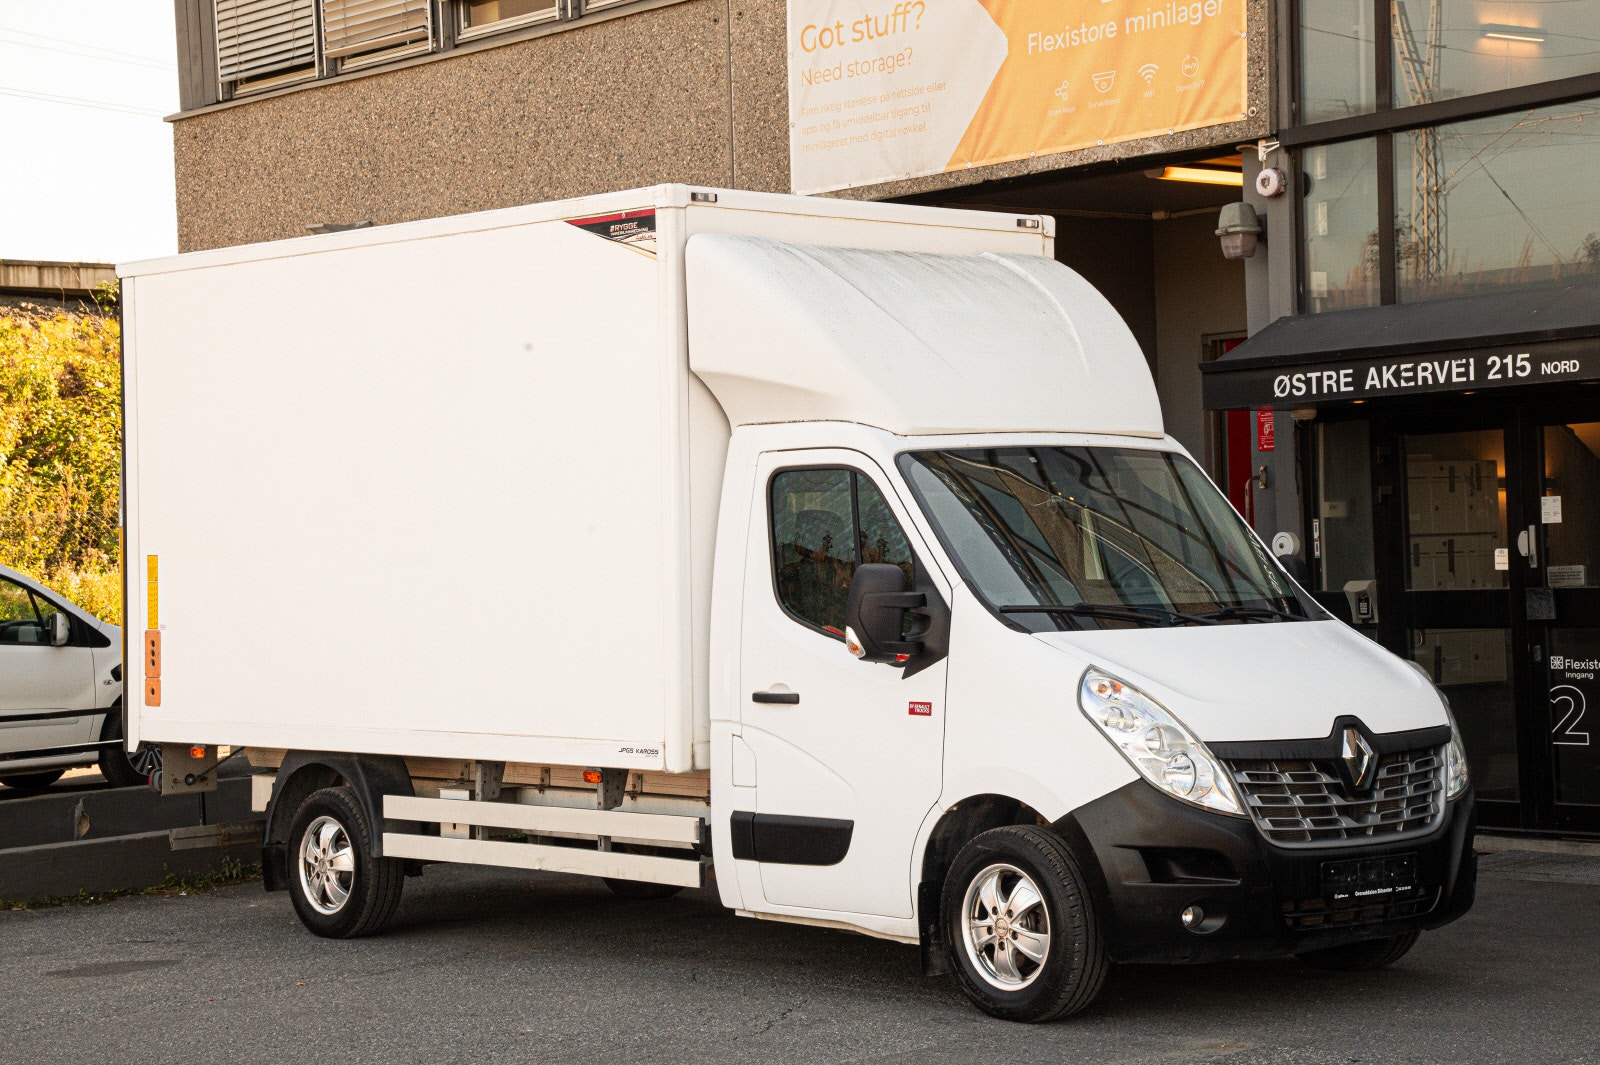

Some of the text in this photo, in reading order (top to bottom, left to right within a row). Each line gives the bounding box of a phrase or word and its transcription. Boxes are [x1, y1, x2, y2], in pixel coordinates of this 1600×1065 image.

[800, 0, 926, 53] Got stuff?
[1028, 0, 1224, 55] Flexistore minilager
[801, 46, 913, 88] Need storage?
[801, 106, 819, 117] Finn
[821, 102, 842, 113] riktig
[880, 92, 891, 104] på
[892, 85, 924, 100] nettside
[927, 81, 947, 93] eller
[820, 123, 830, 133] og
[832, 119, 840, 129] få
[843, 112, 889, 128] umiddelbar
[892, 106, 919, 119] tilgang
[921, 101, 931, 113] til
[802, 137, 848, 152] minilageret
[850, 133, 868, 144] med
[871, 128, 896, 141] digital
[614, 222, 638, 232] RYGGE
[1273, 353, 1580, 398] ØSTRE AKERVEI 215 NORD
[1565, 671, 1594, 680] Inngang
[1549, 684, 1590, 746] 2
